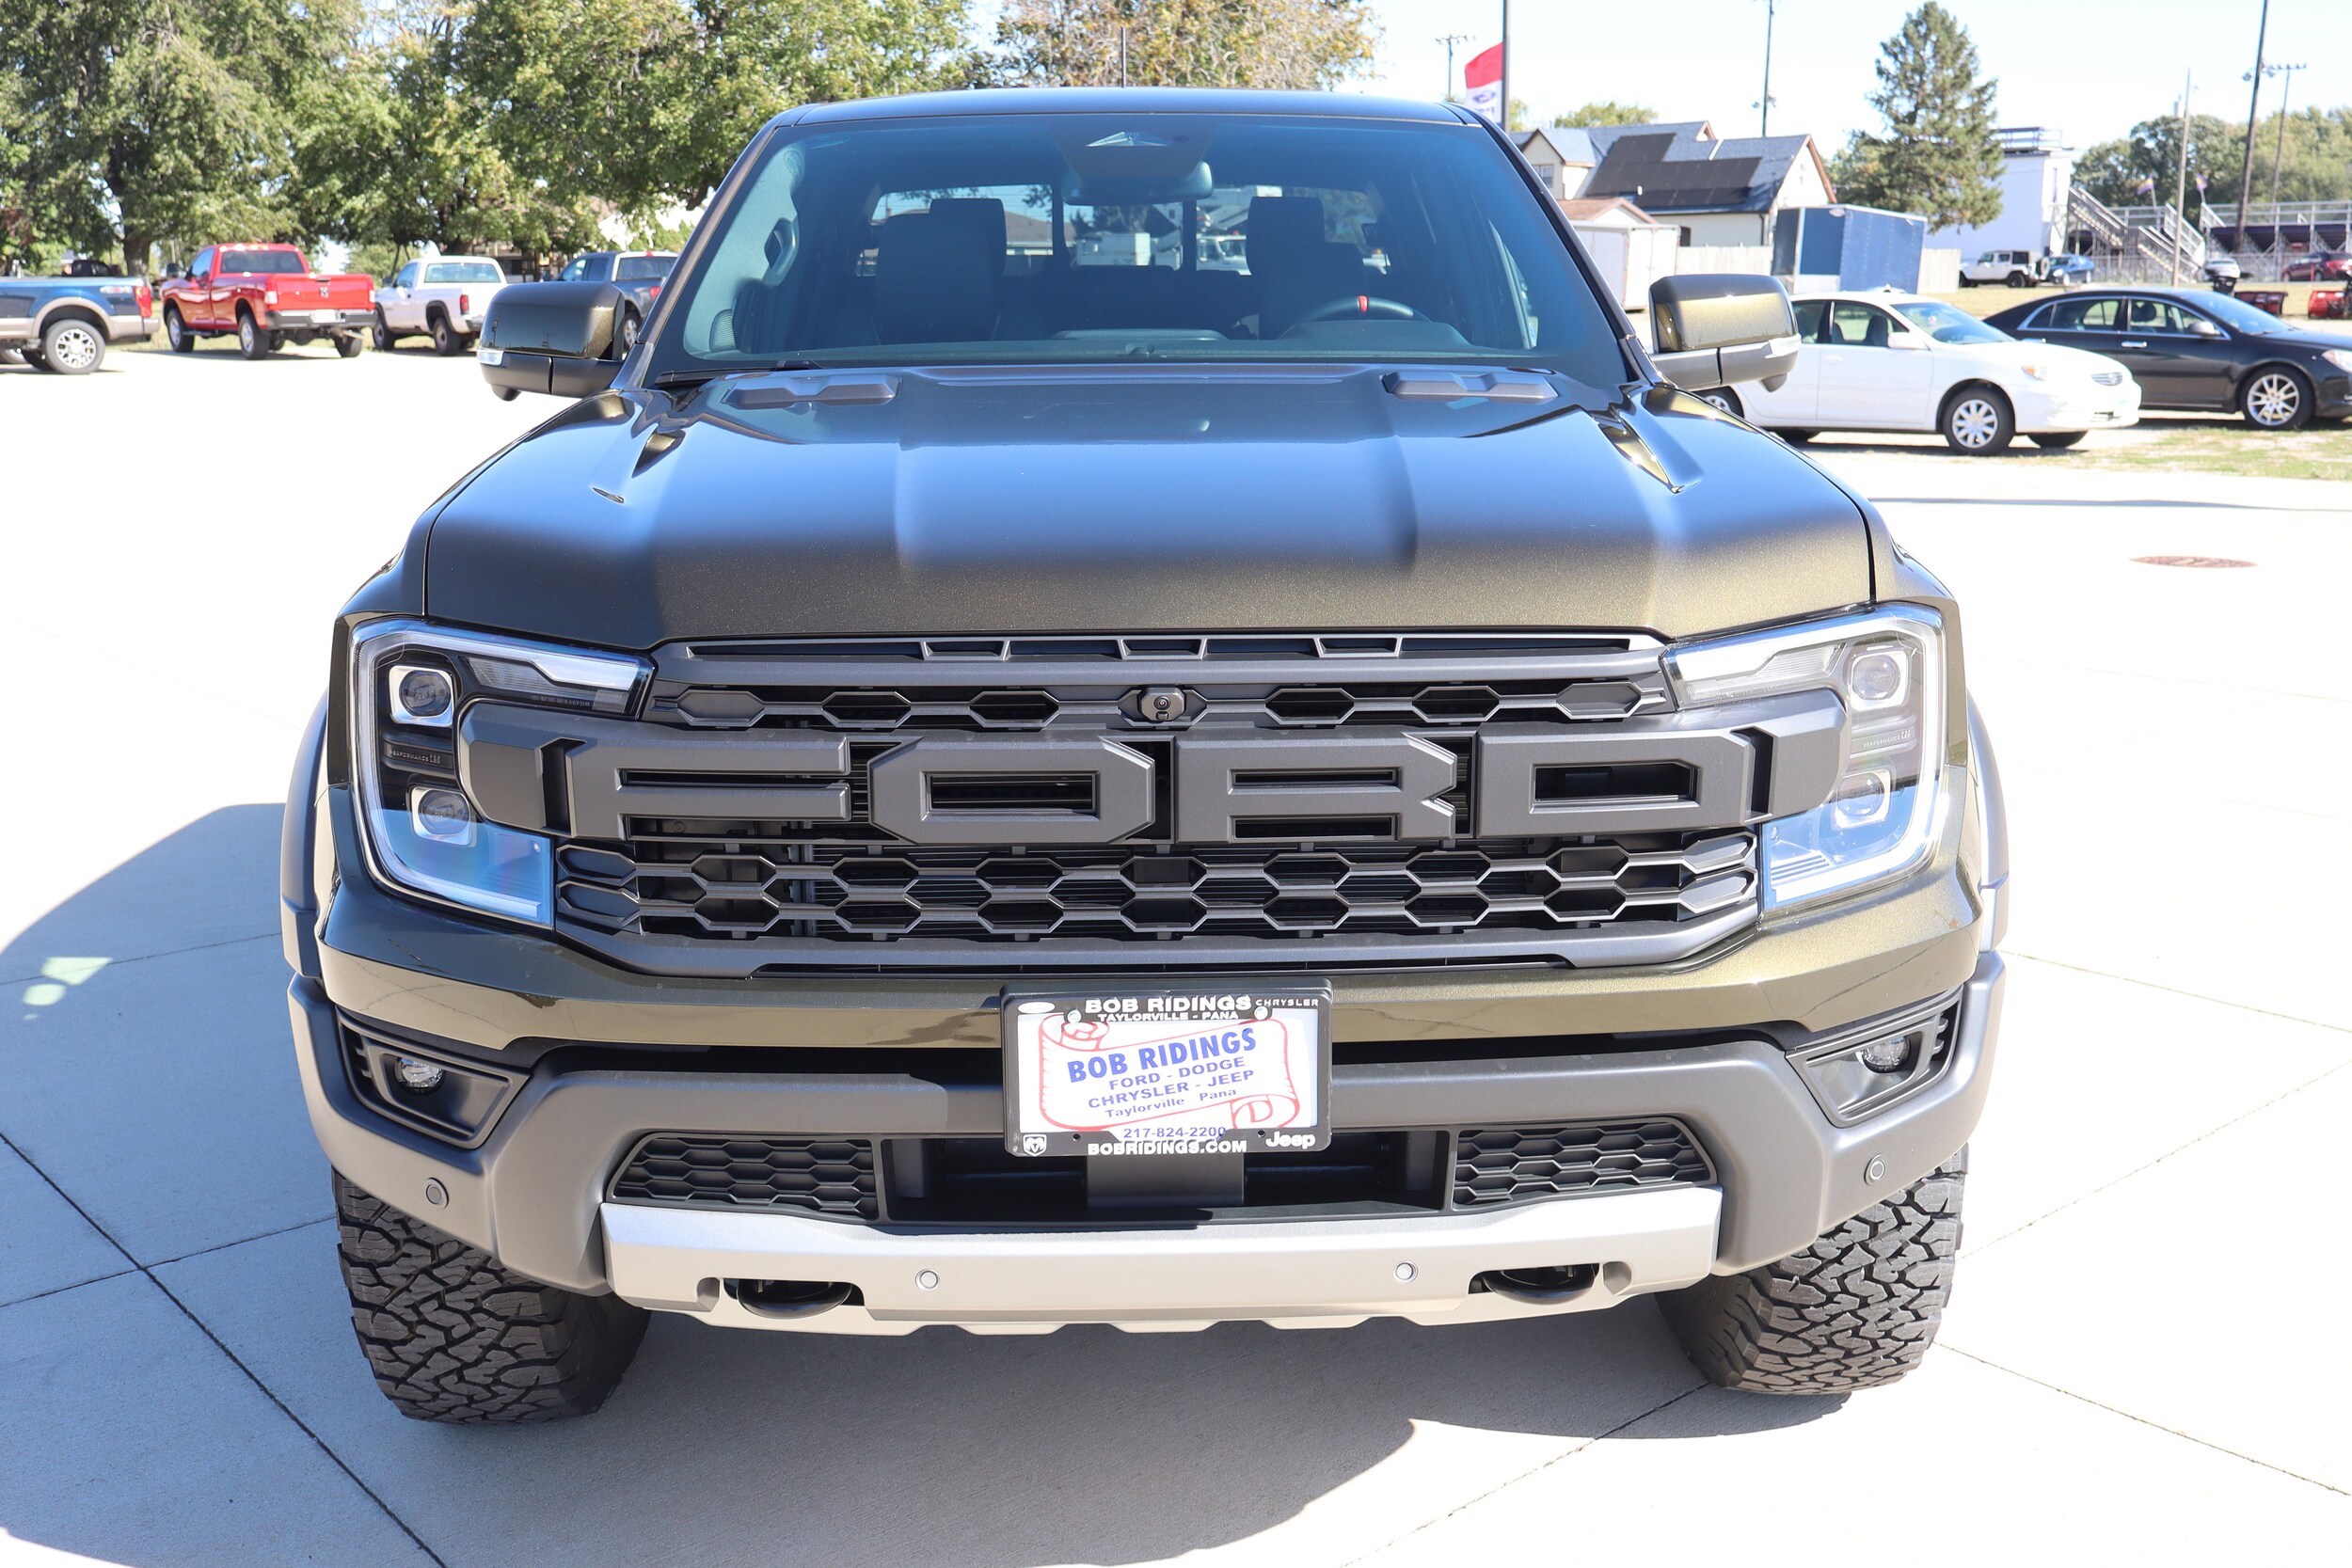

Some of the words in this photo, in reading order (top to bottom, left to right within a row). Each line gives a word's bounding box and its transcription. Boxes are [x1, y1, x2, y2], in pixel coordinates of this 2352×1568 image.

[564, 730, 1756, 843] FORD
[1085, 998, 1138, 1014] BOB
[1147, 994, 1252, 1012] RIDINGS
[1097, 1013, 1189, 1022] TAYLORVILLE
[1067, 1053, 1127, 1083] BOB
[1138, 1027, 1256, 1069] RIDINGS
[1109, 1073, 1160, 1090] FORD
[1179, 1056, 1246, 1078] DODGE
[1088, 1082, 1189, 1108] CHRYSLER
[1207, 1069, 1254, 1087] JEEP
[1104, 1099, 1184, 1117] Taylorville
[1200, 1089, 1237, 1101] Pana
[1123, 1127, 1226, 1137] 217-824-2200
[1265, 1132, 1316, 1149] Jeep
[1088, 1140, 1248, 1155] BOBRIDINGS.COM
